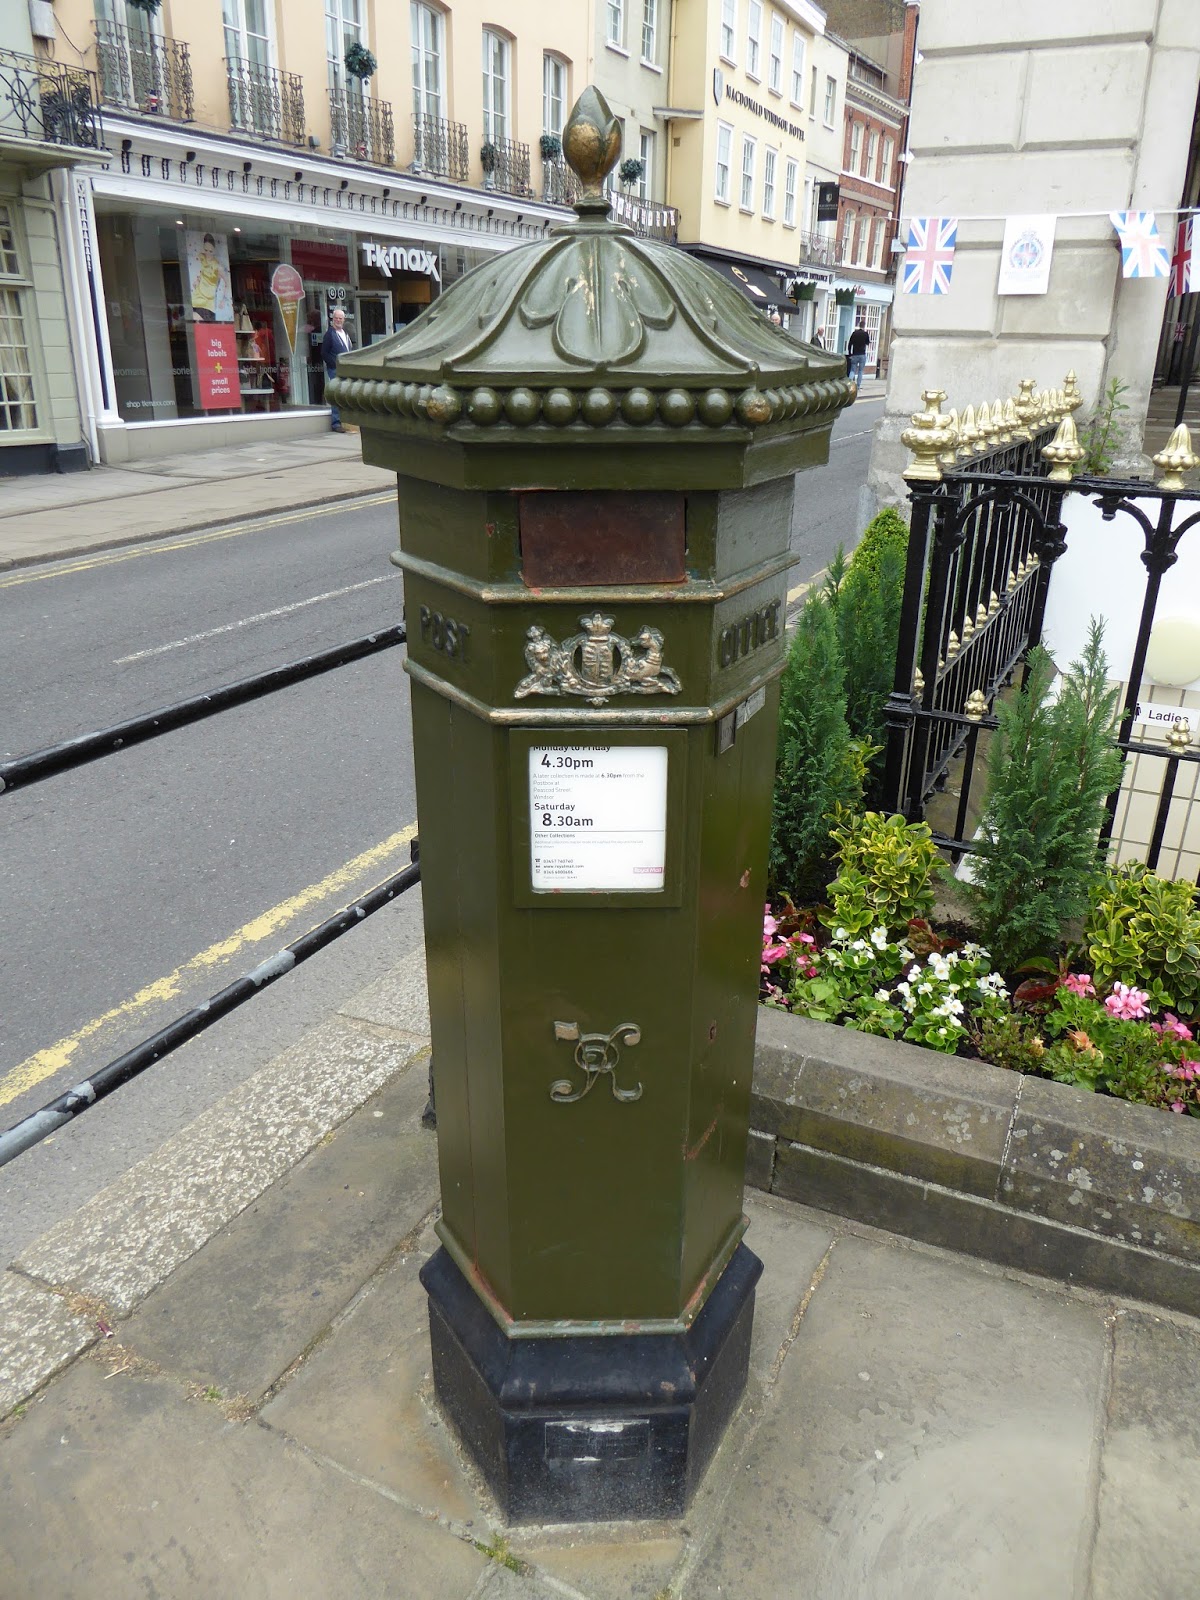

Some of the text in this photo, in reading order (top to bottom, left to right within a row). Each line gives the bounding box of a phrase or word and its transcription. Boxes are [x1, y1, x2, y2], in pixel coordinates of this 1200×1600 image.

[726, 84, 805, 142] MACDONALD WINDSOR HOTEL
[211, 339, 222, 349] big
[208, 349, 227, 357] labels
[211, 377, 228, 385] small
[211, 386, 230, 394] prices
[420, 604, 470, 662] POST
[719, 598, 782, 669] OFFICE
[541, 753, 594, 770] 4.30pm
[534, 803, 575, 811] Saturday
[542, 812, 593, 827] 8.30am
